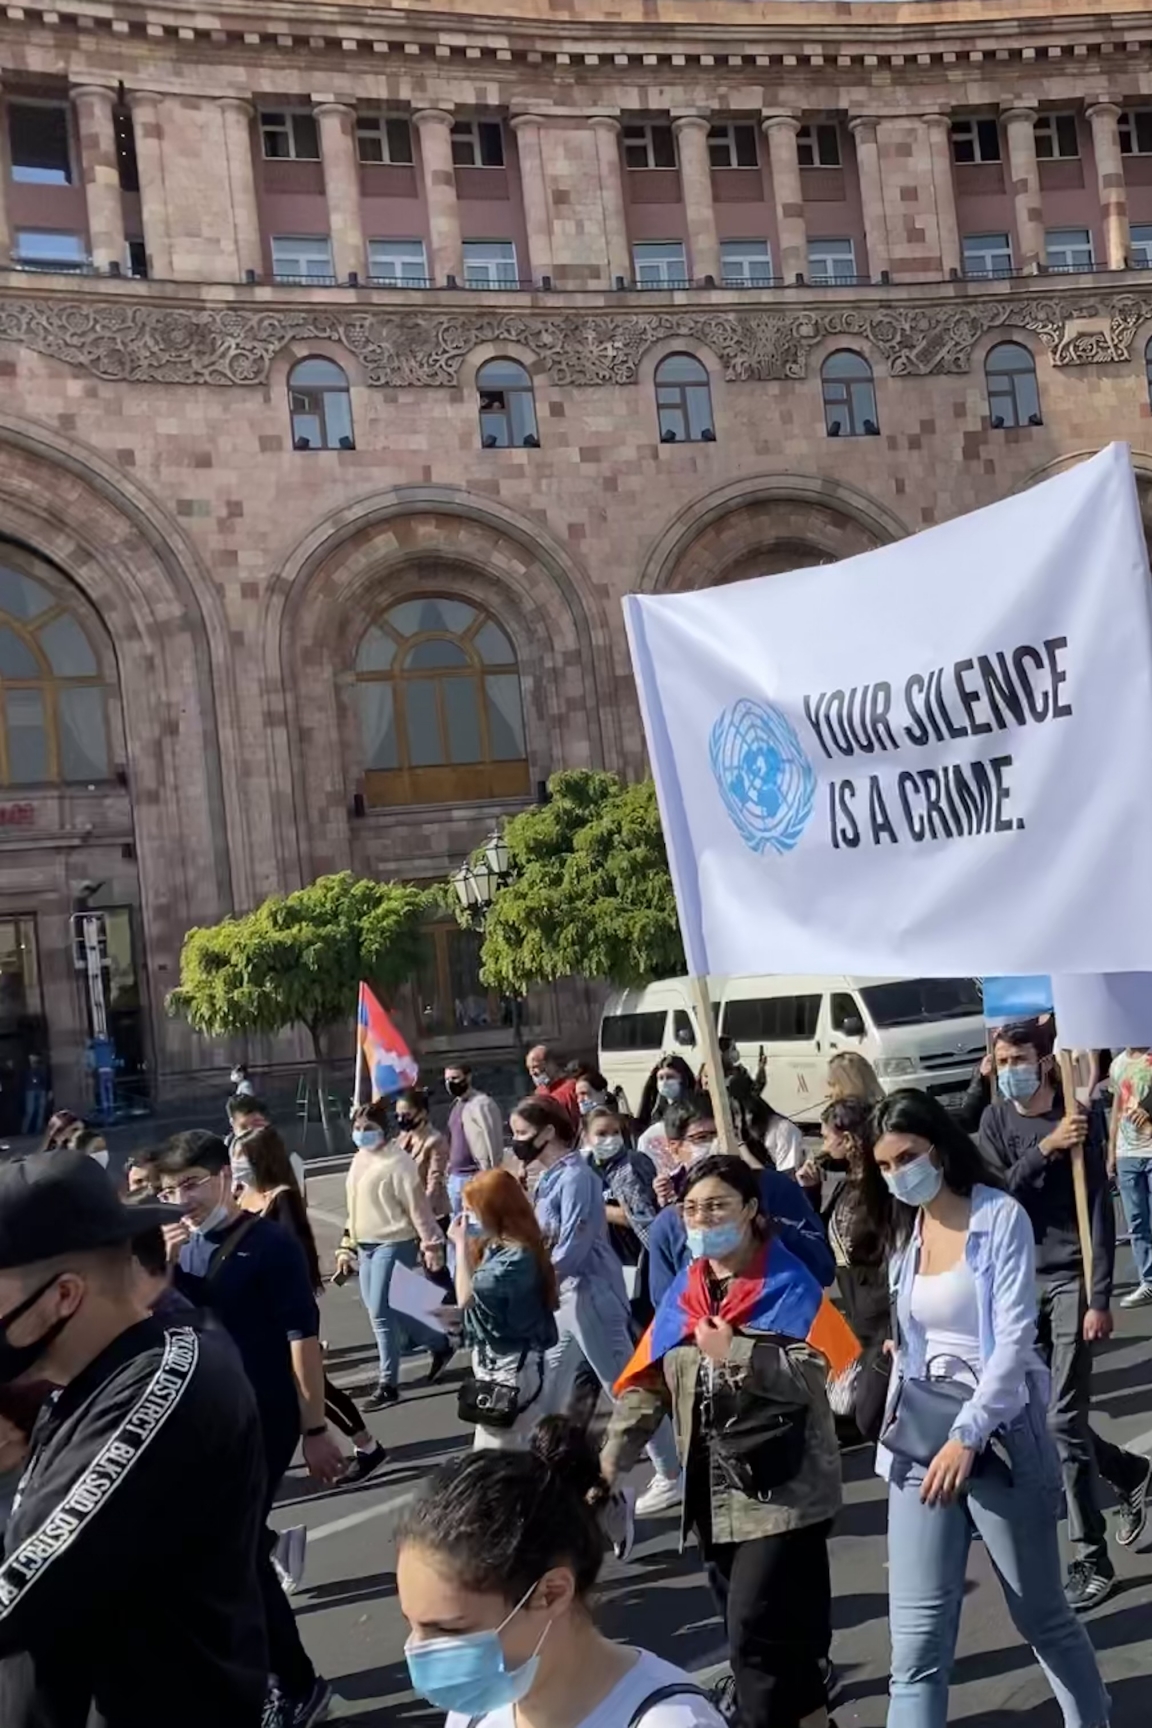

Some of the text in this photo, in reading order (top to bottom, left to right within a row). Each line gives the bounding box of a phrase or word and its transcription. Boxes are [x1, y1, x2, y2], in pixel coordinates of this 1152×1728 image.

[803, 636, 1073, 759] YOUR SILENCE
[829, 755, 1025, 849] IS A CRIME.
[125, 1372, 184, 1440] DSTRCT
[12, 1512, 80, 1580] DSTRCT
